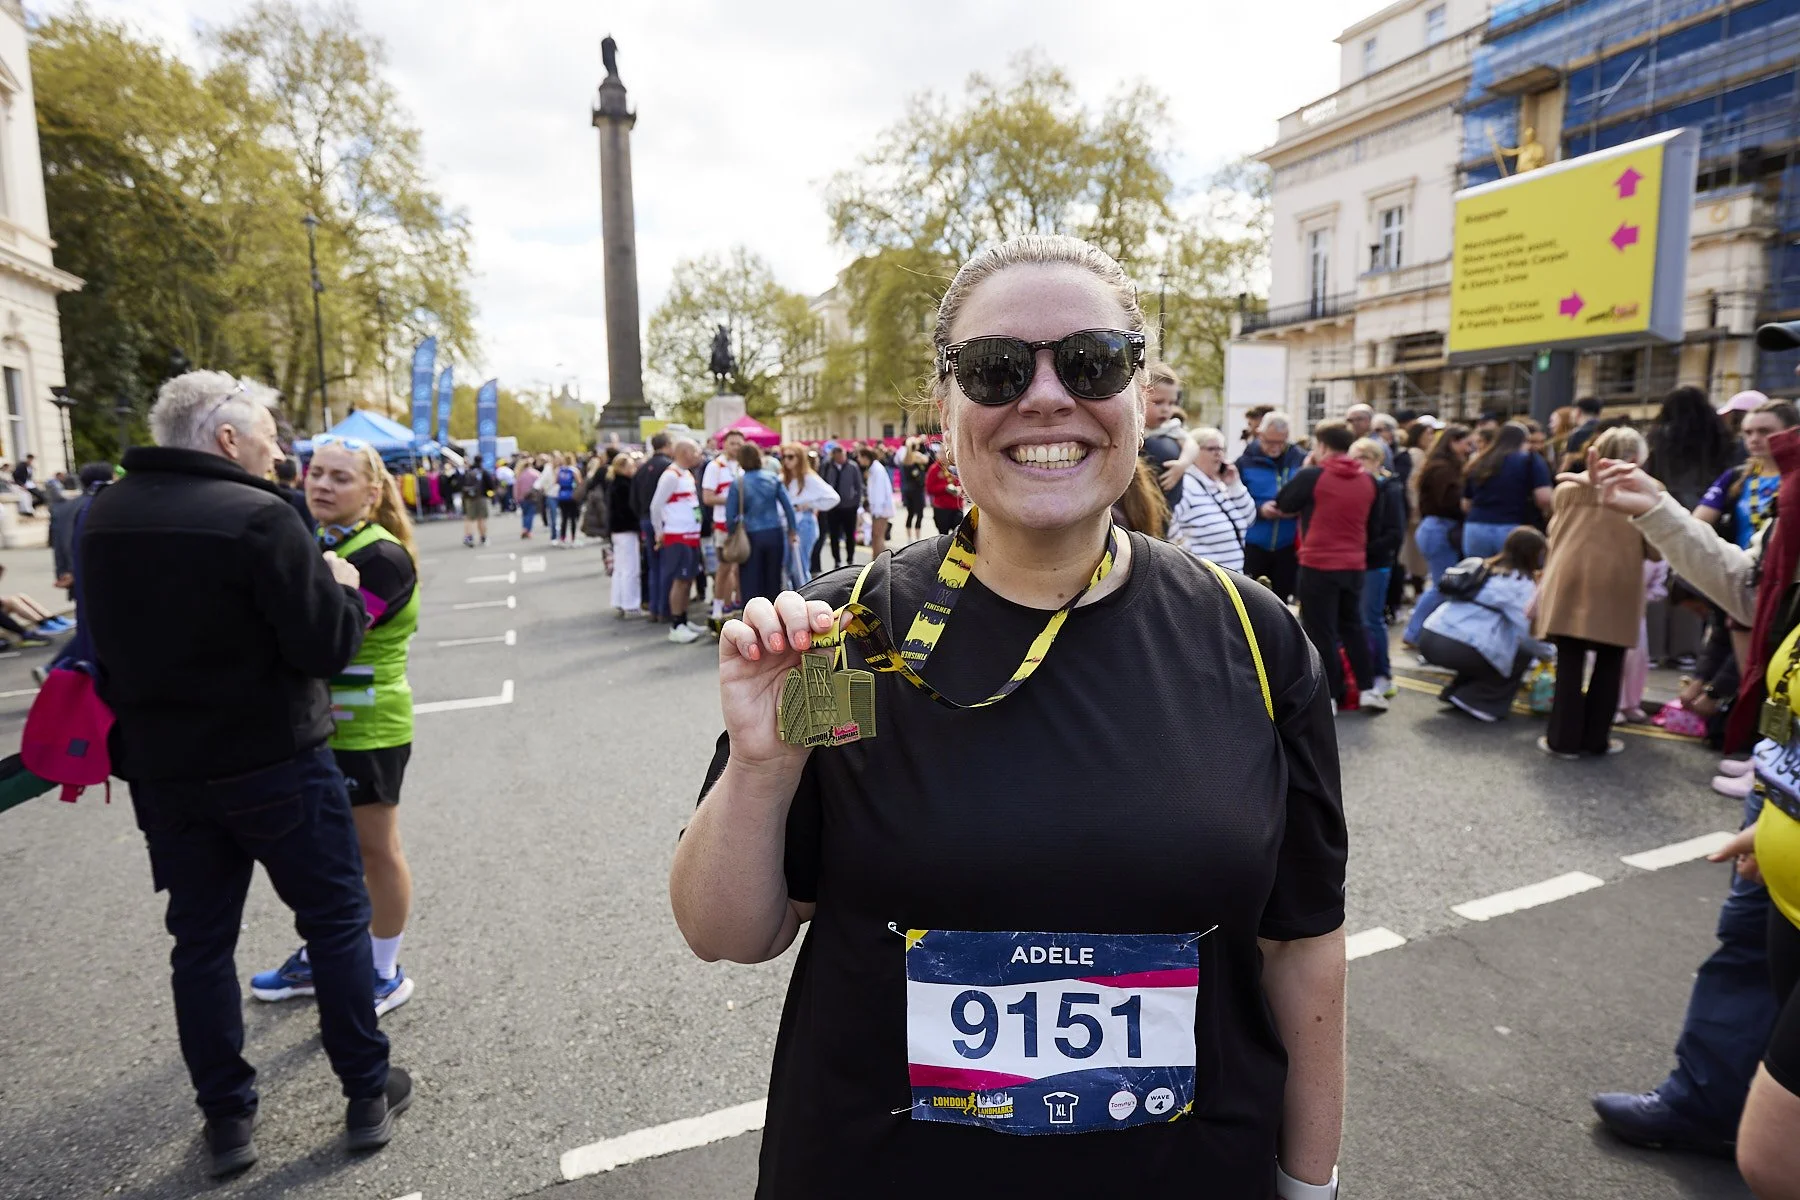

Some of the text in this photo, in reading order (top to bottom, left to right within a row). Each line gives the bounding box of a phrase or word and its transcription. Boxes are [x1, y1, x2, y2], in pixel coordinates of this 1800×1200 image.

[923, 601, 952, 615] FINISHER
[805, 731, 828, 745] LONDON
[1011, 946, 1095, 966] ADELE
[950, 989, 1143, 1060] 9151
[933, 1096, 1013, 1116] LONDON LANDMARKS
[1055, 1103, 1067, 1117] XL
[1111, 1101, 1136, 1109] Tommy's
[1154, 1101, 1164, 1111] 4
